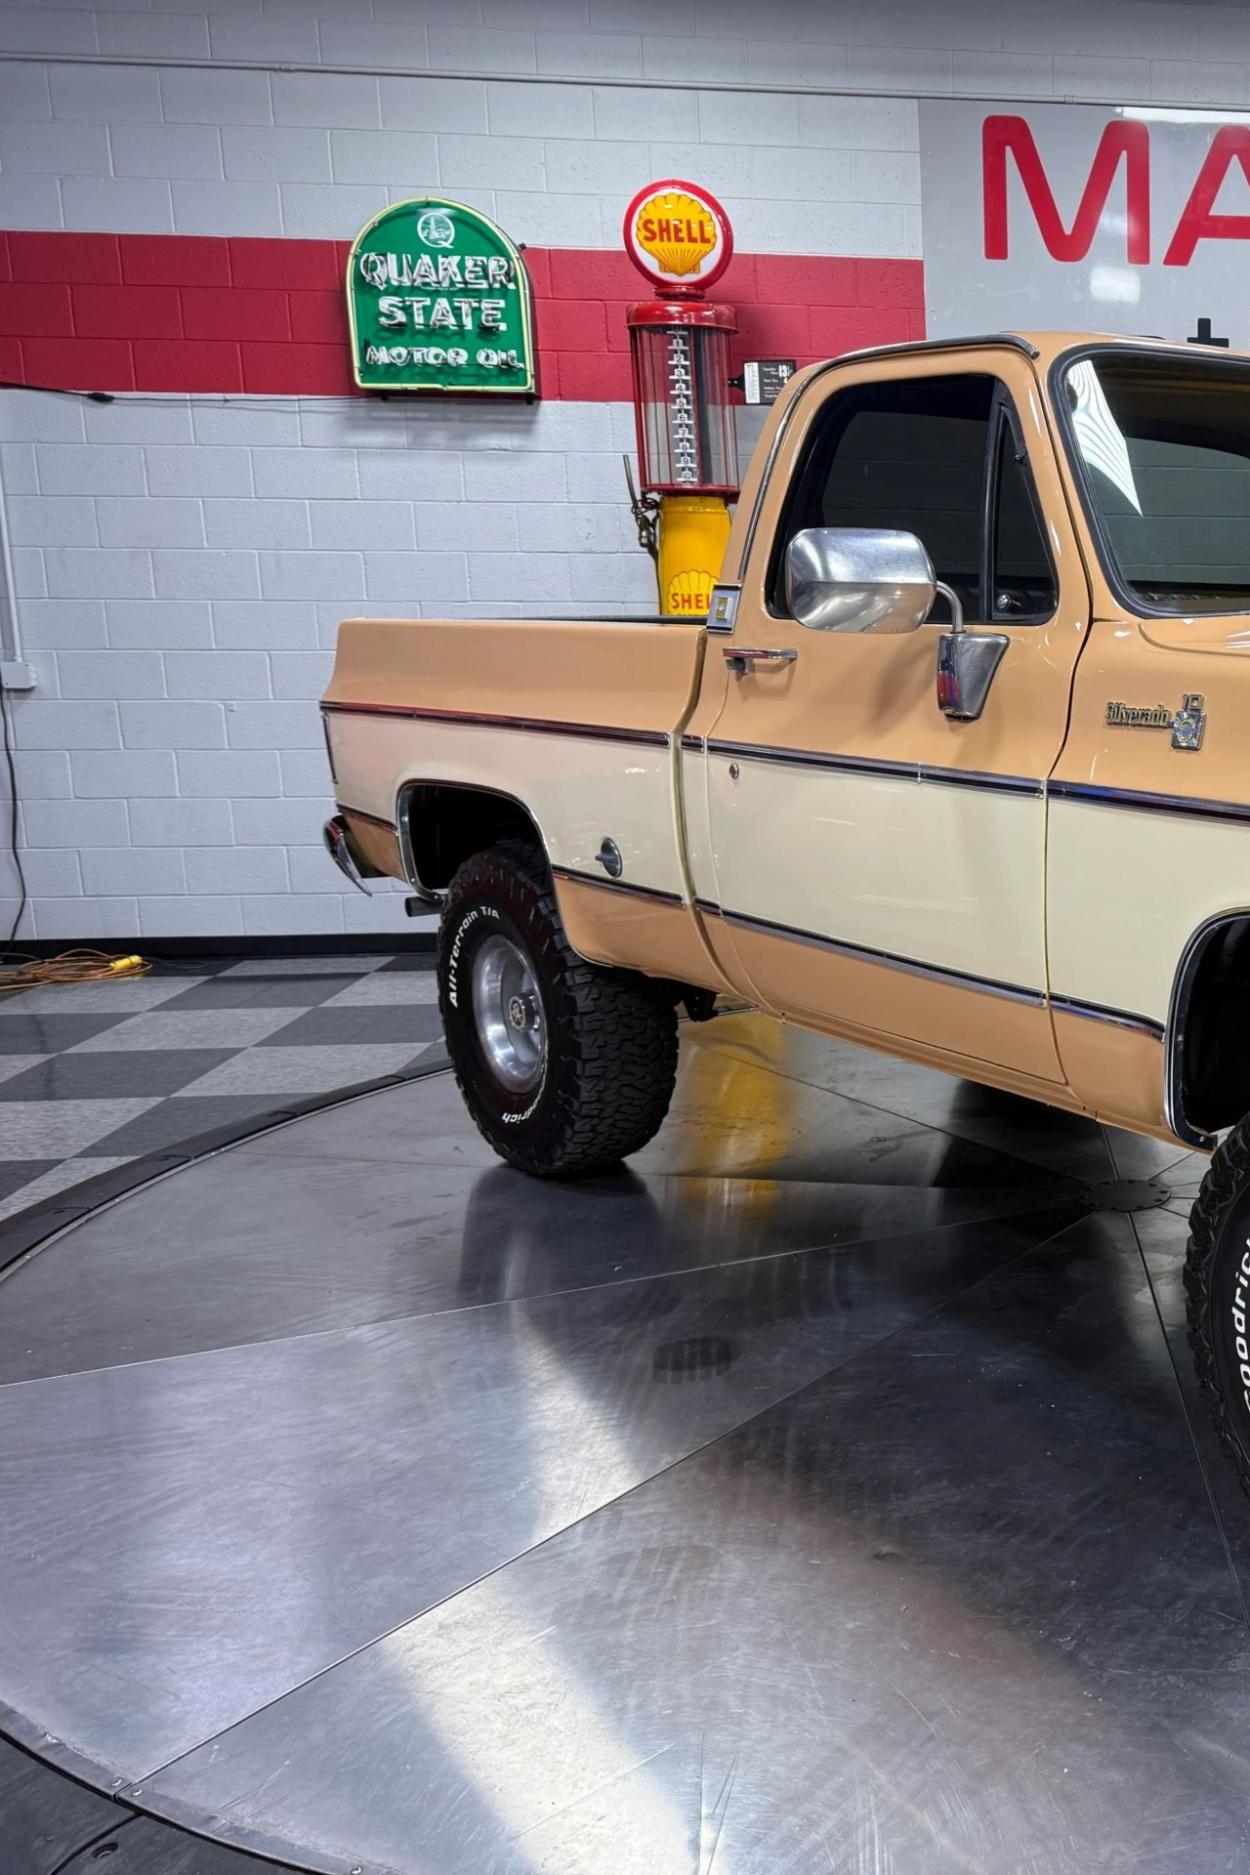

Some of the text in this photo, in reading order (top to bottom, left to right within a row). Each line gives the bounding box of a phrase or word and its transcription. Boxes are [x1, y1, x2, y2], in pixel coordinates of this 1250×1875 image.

[642, 218, 712, 245] SHELL
[360, 252, 517, 290] QUAKER
[378, 296, 508, 332] STATE
[366, 346, 469, 366] MOTOR
[449, 911, 478, 1008] All-Terrain
